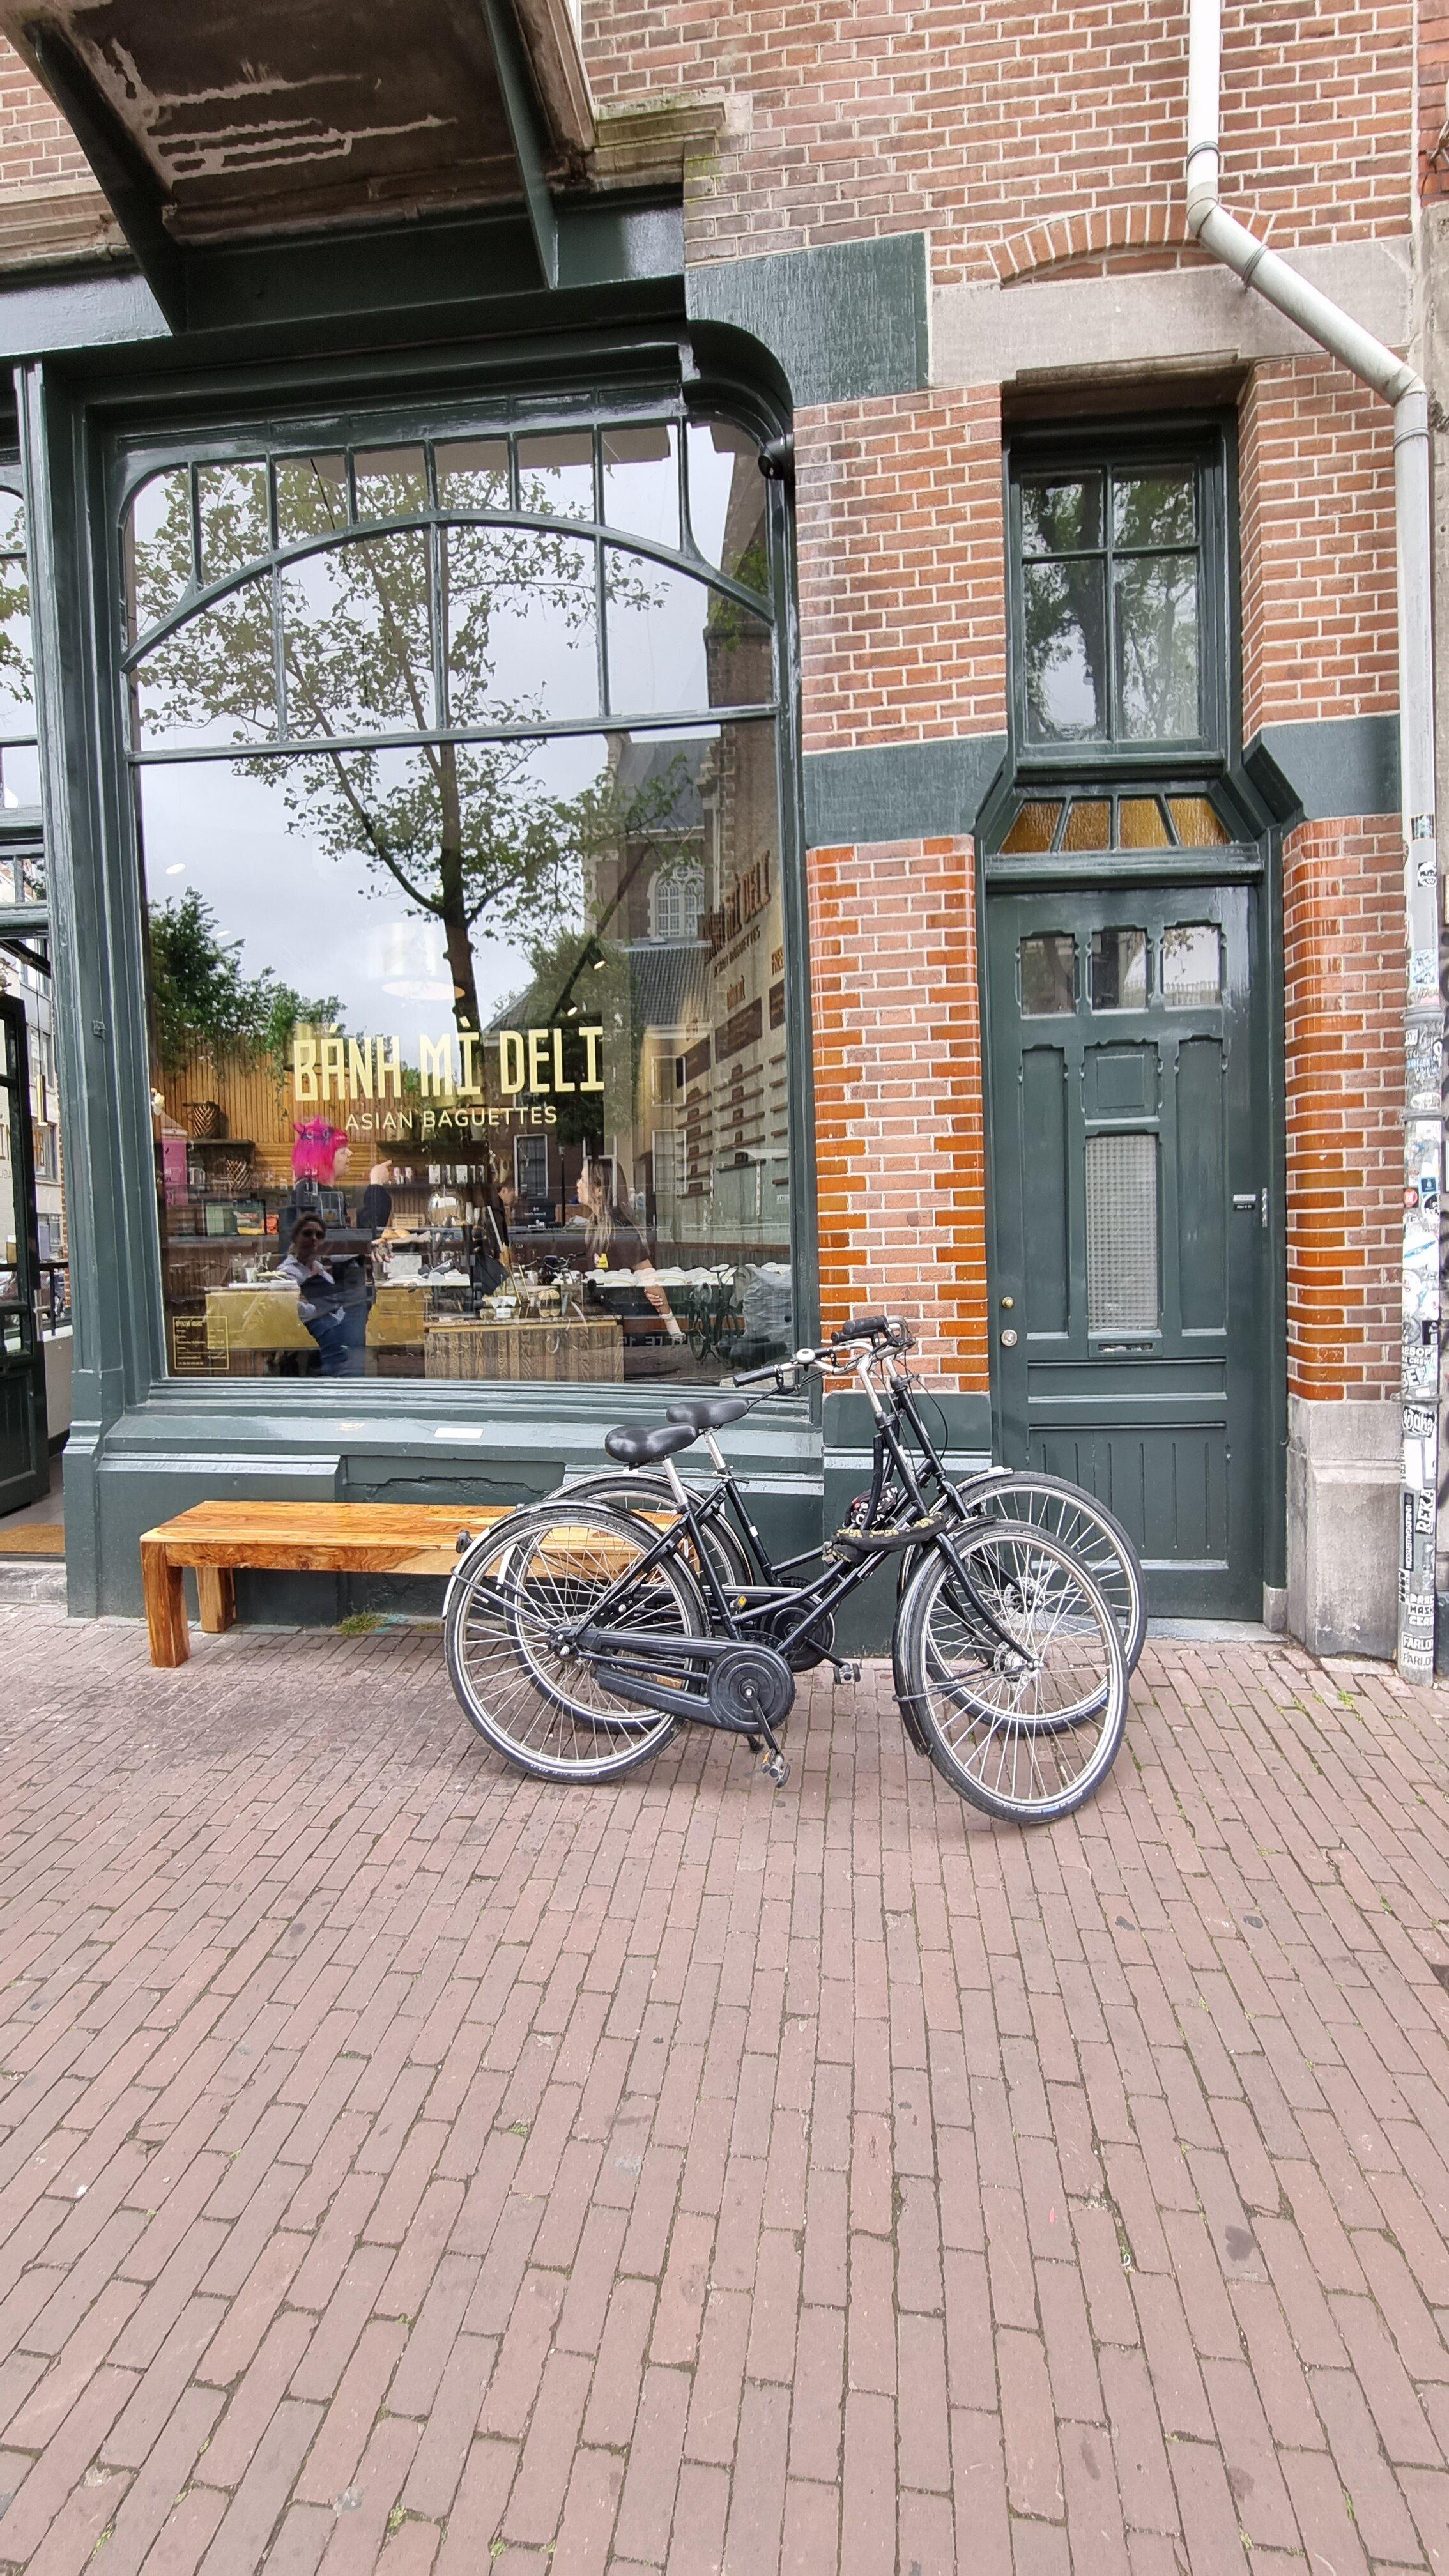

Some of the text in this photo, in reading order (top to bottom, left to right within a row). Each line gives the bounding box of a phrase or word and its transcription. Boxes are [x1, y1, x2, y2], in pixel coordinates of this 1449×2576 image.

[293, 1016, 605, 1102] BÁNH MÌ DELI
[345, 1106, 558, 1131] ASIAN BAGUETTES
